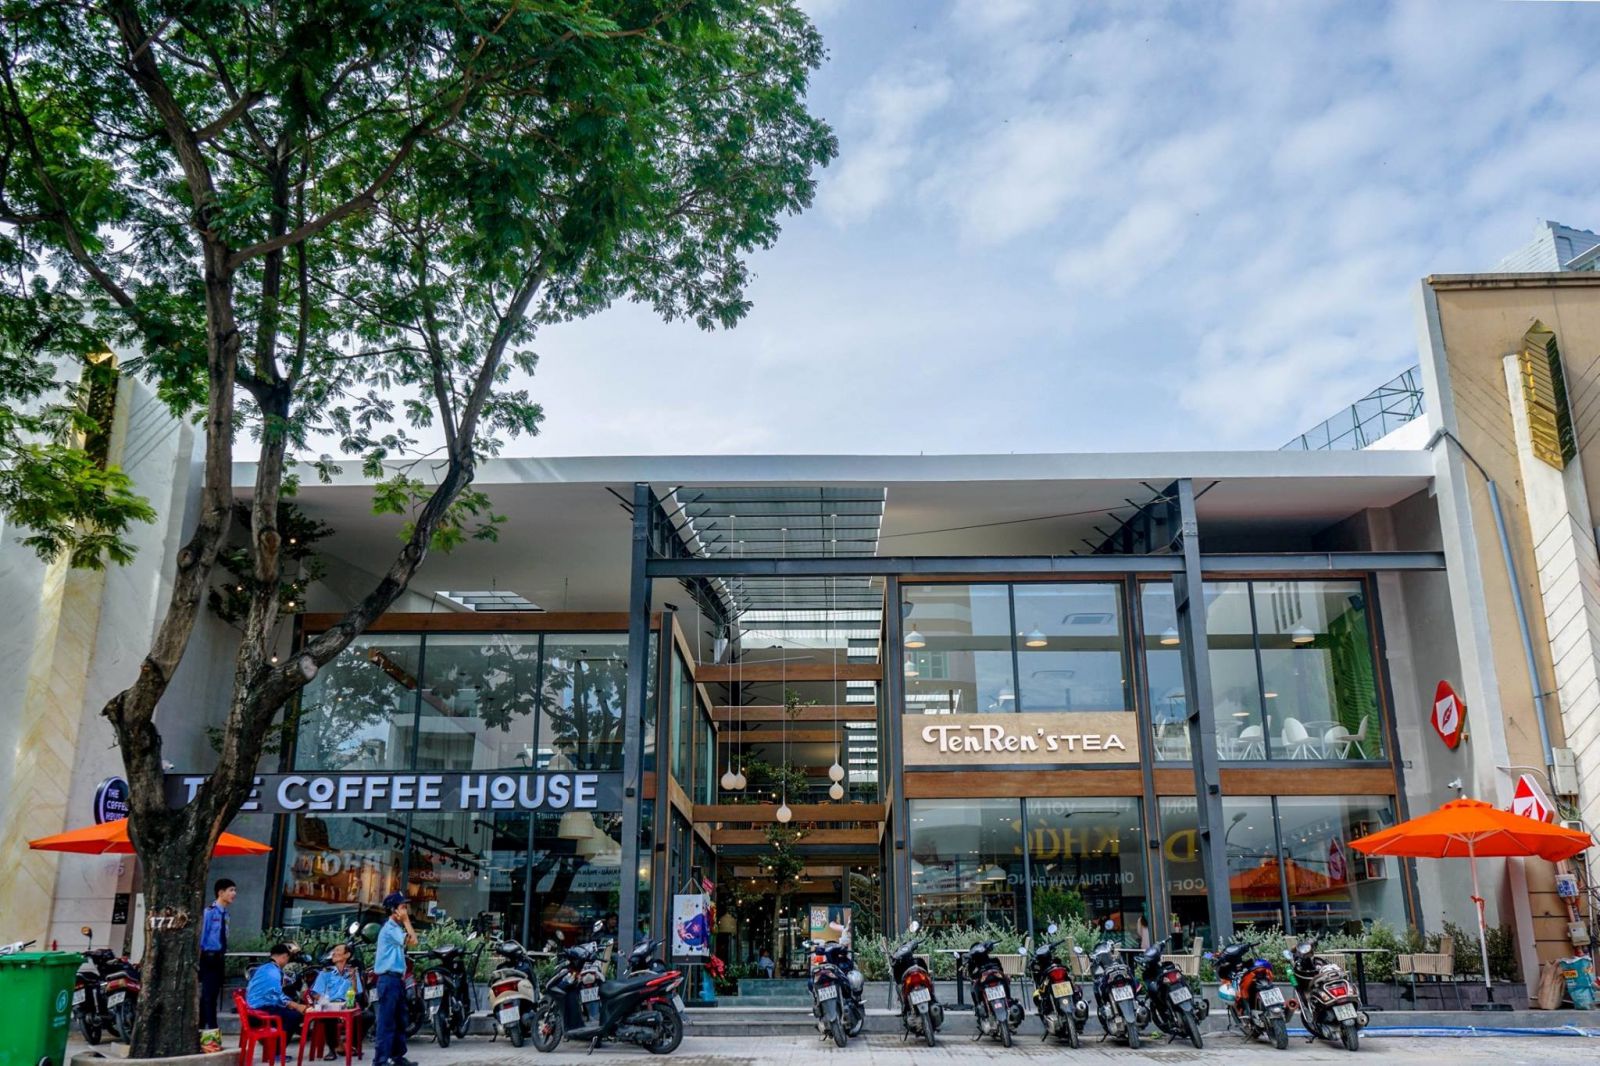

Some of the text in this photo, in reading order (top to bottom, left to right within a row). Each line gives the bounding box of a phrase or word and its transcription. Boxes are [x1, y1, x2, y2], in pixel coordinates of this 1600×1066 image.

[1060, 734, 1126, 751] TEA
[108, 788, 119, 799] THE
[277, 775, 441, 811] COFFEE
[460, 774, 598, 809] HOUSE
[150, 916, 175, 928] 177
